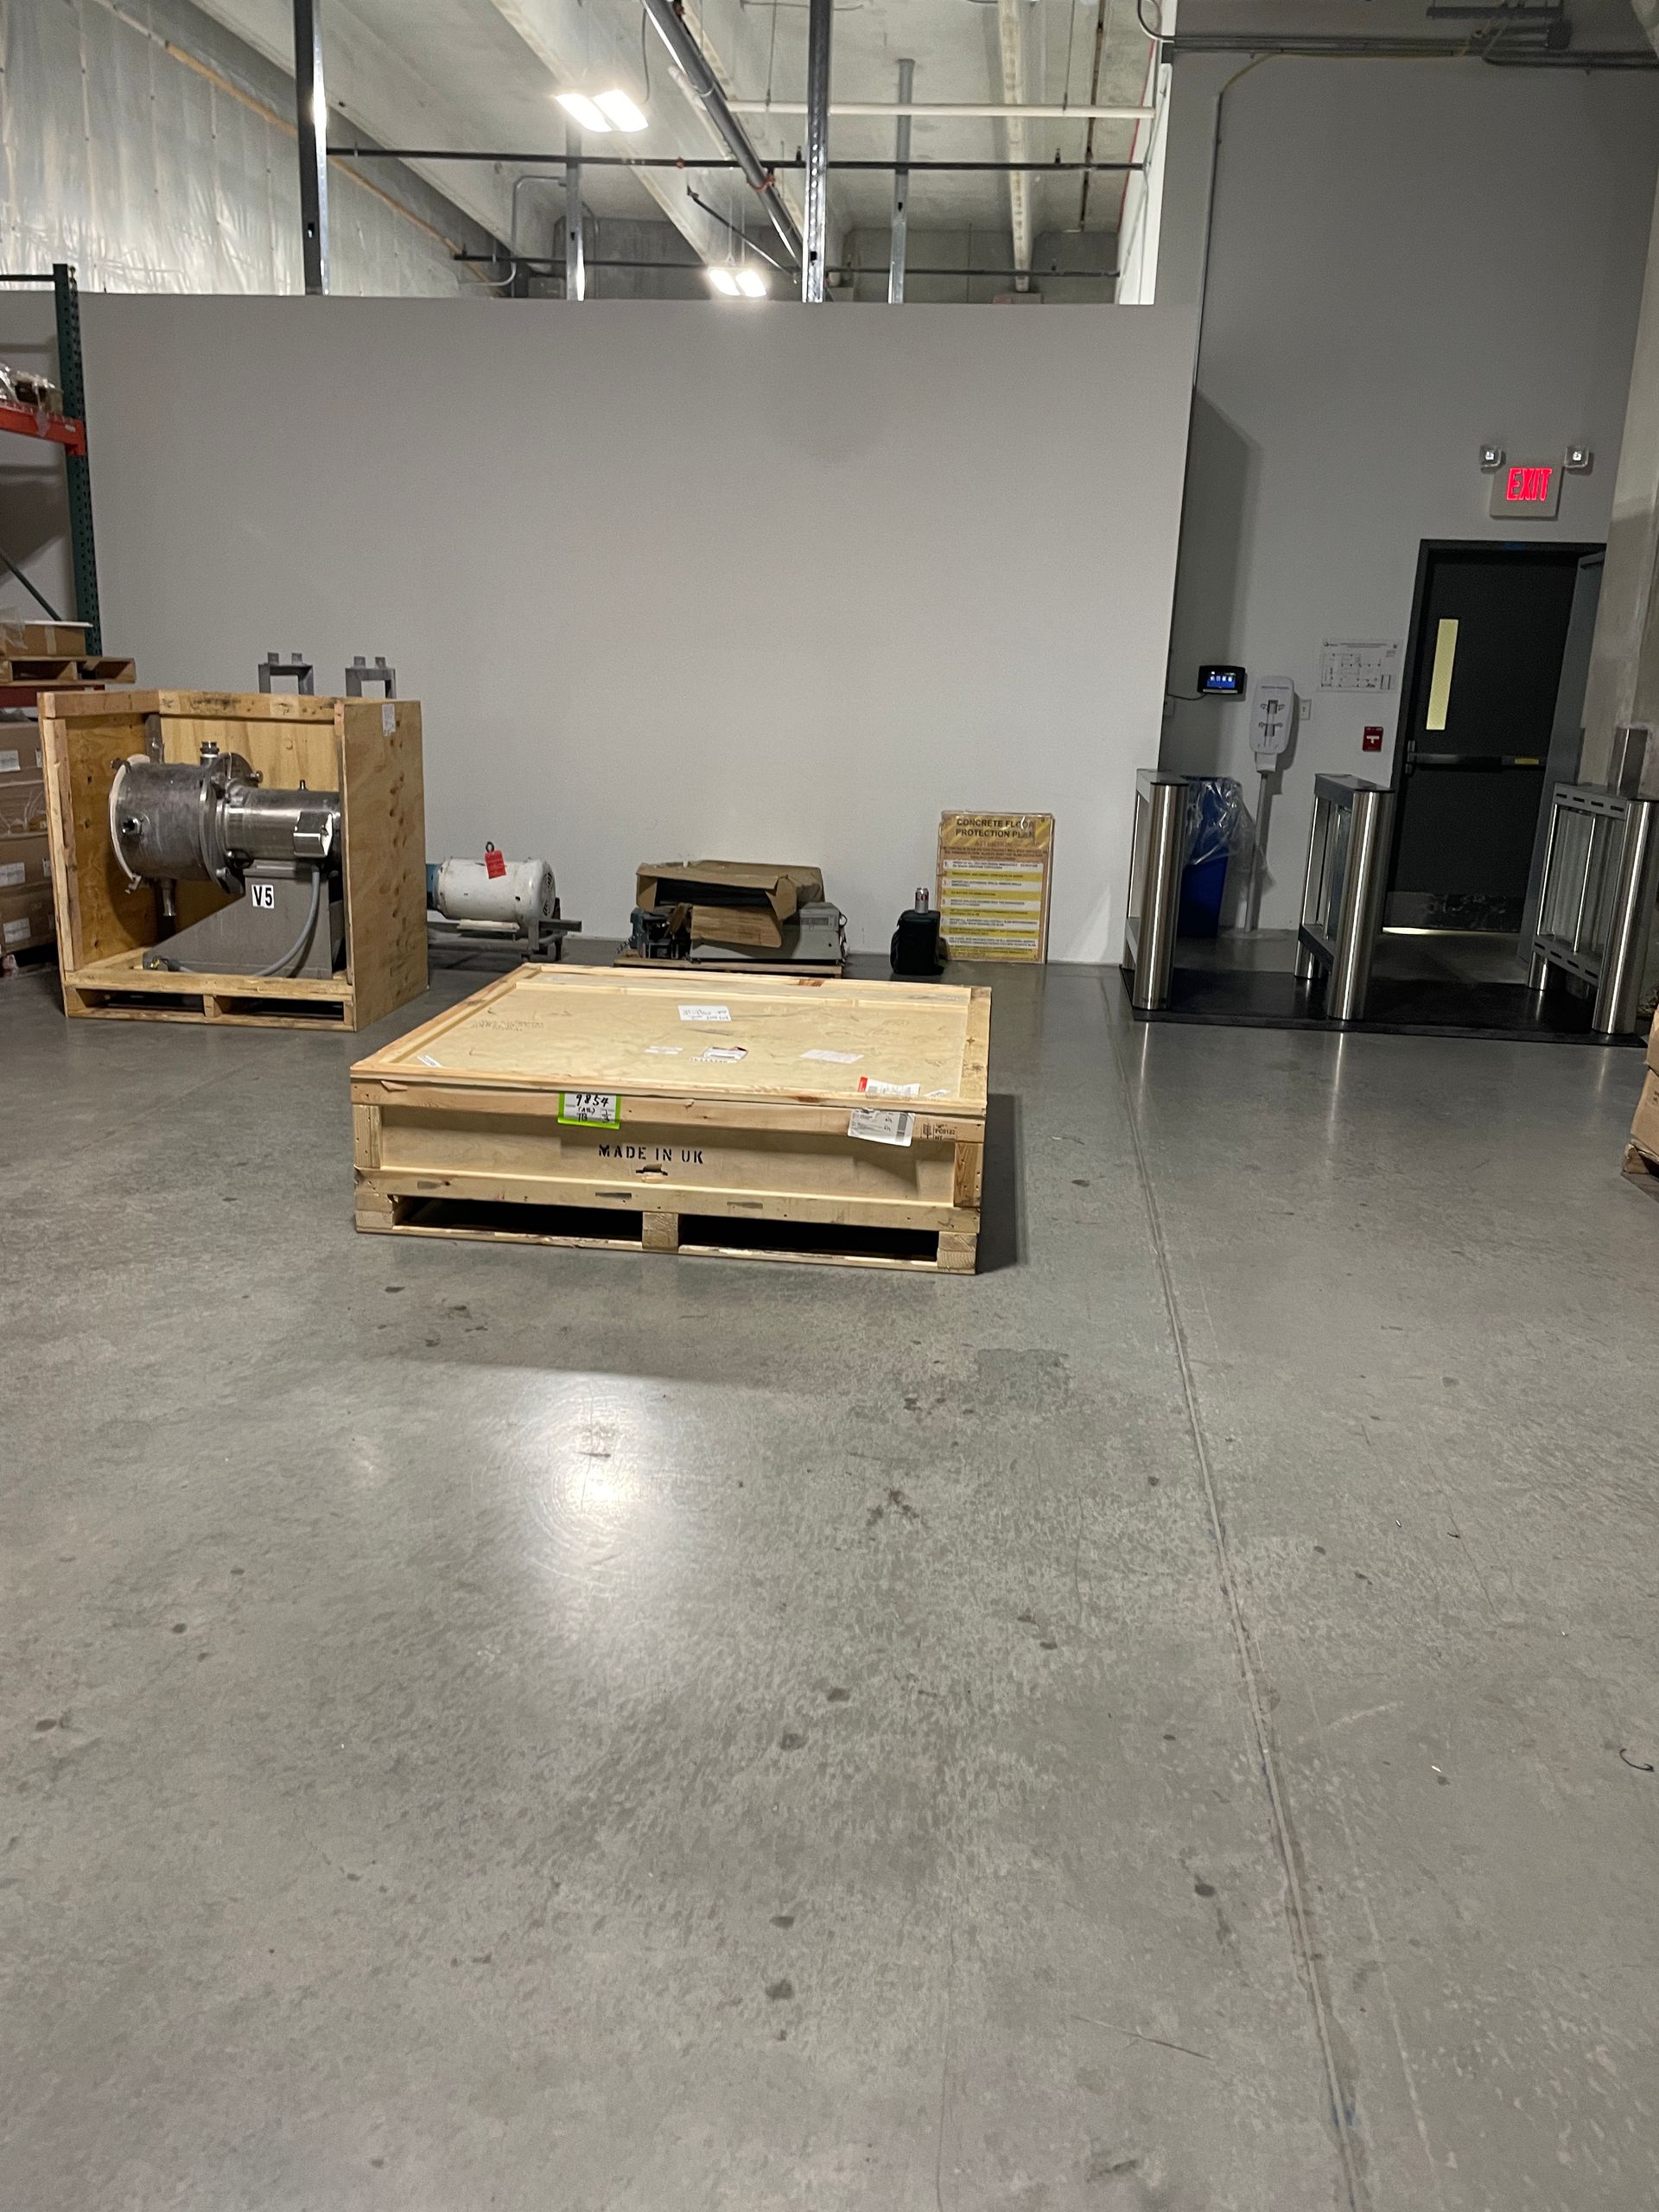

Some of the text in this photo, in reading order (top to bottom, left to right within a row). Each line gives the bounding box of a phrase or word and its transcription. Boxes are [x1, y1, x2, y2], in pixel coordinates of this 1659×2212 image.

[1506, 467, 1552, 501] EXIT
[957, 818, 1003, 828] CONCRETE
[956, 829, 1010, 837] PROTECTION
[253, 886, 272, 906] V5
[576, 1094, 609, 1107] 9854
[599, 1145, 703, 1164] MADE IN UK
